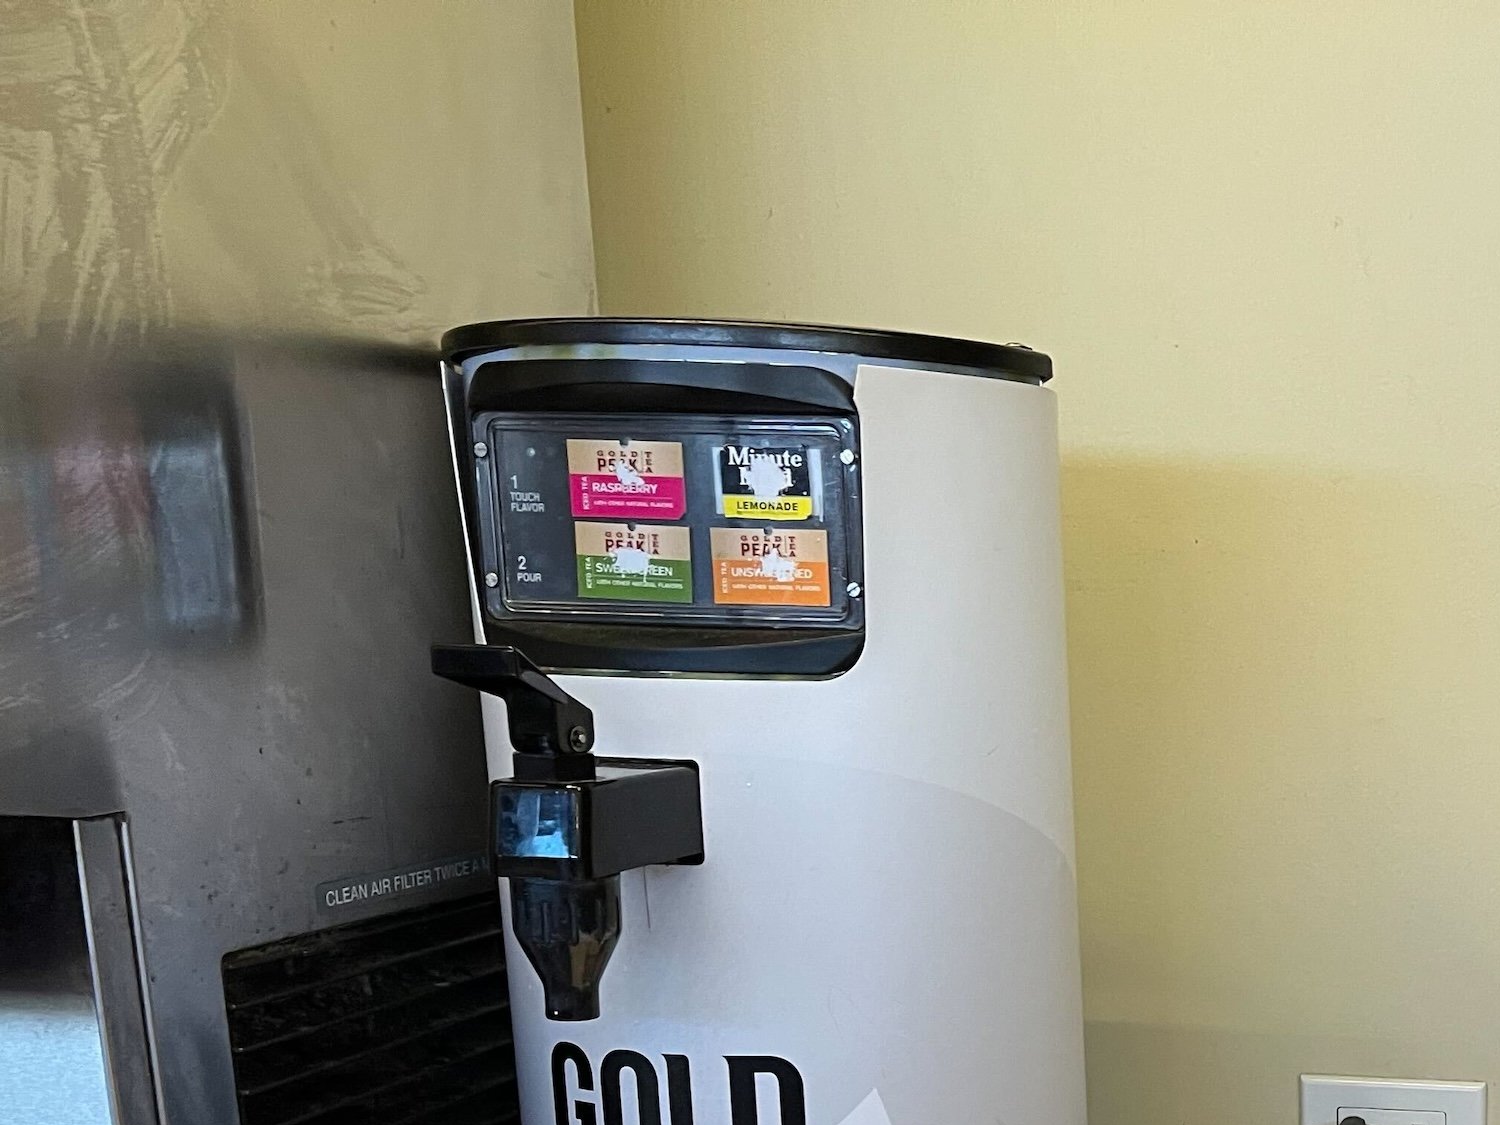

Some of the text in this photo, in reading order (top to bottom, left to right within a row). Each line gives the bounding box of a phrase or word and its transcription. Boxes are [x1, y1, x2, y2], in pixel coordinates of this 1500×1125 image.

[597, 450, 638, 458] GOLD
[510, 475, 518, 489] 1
[510, 491, 541, 502] TOUCH
[511, 502, 545, 513] FLAVOR
[736, 501, 799, 511] LEMONADE
[605, 531, 645, 539] GOLD
[517, 555, 527, 570] 2
[517, 572, 542, 582] POUR
[326, 884, 368, 907] CLEAN
[371, 878, 391, 896] AIR
[393, 869, 433, 891] FILTER
[434, 862, 470, 881] TWICE
